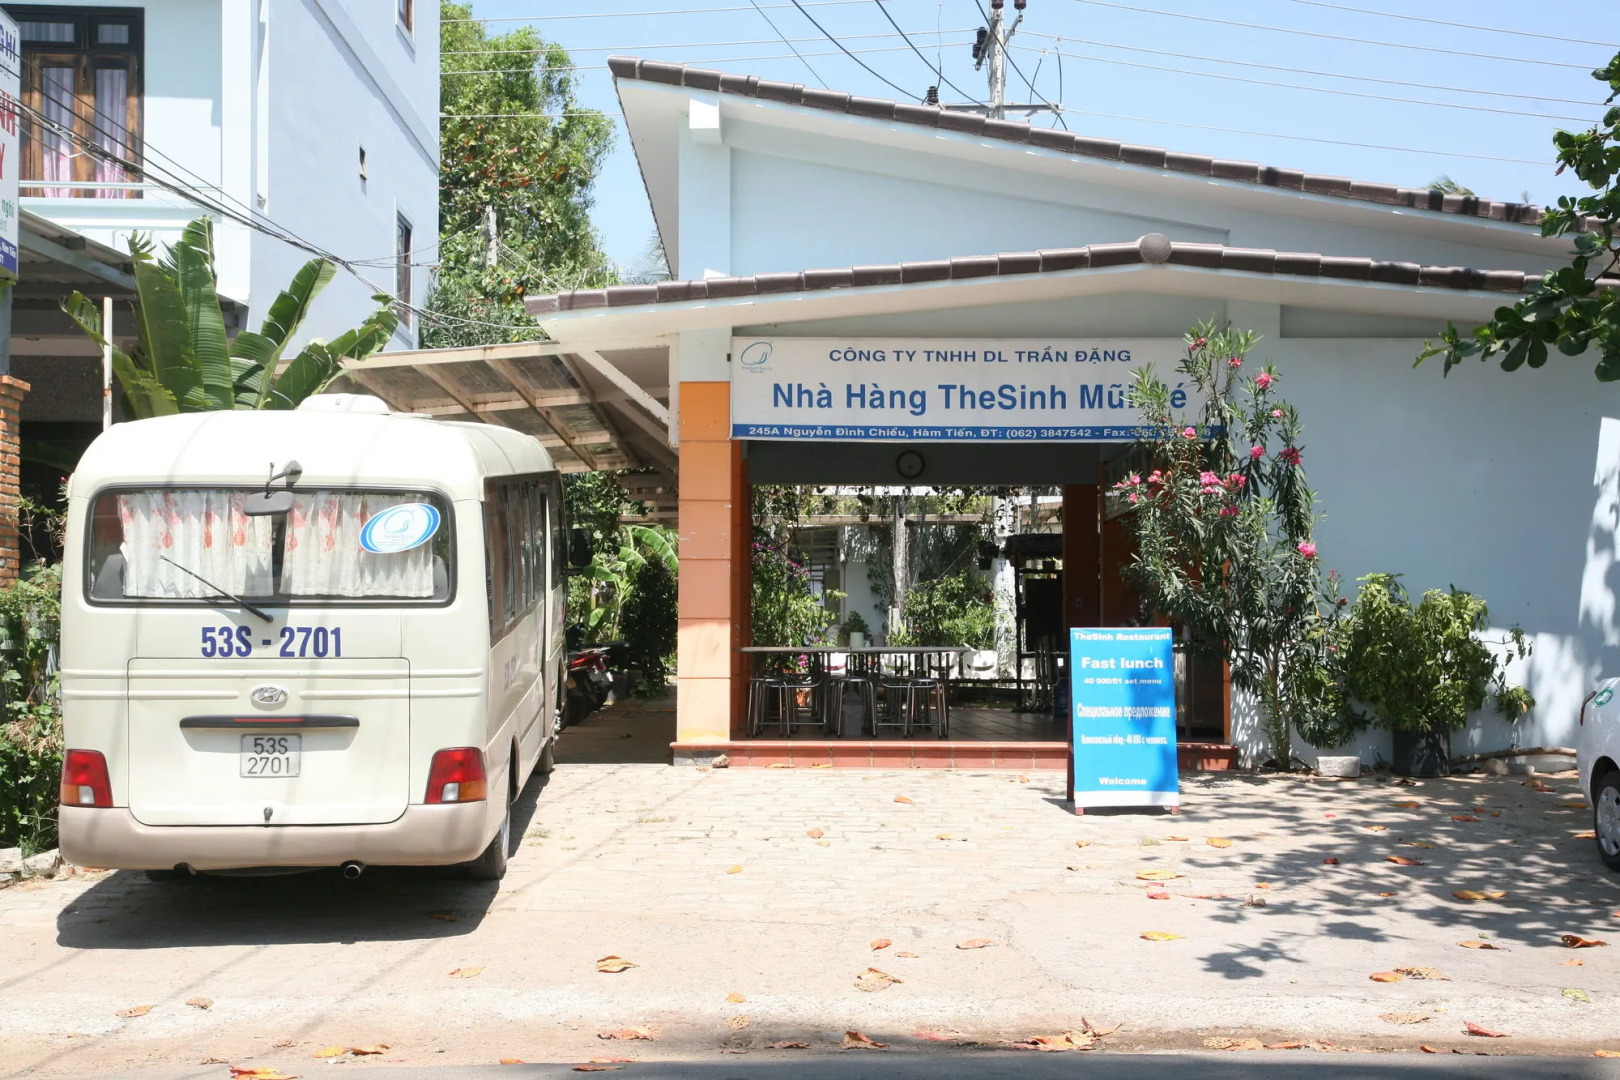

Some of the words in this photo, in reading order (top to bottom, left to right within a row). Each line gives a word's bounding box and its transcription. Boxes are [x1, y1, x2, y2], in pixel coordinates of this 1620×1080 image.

[829, 347, 886, 362] CÔNG
[893, 350, 917, 362] TY
[923, 350, 976, 362] TNHH
[984, 350, 1008, 363] DL
[1014, 345, 1068, 363] TRẦN
[1075, 347, 1131, 365] ĐẶNG
[773, 383, 833, 409] Nhà
[846, 383, 927, 416] Hàng
[938, 383, 1067, 410] TheSinh
[749, 427, 780, 436] 245A
[784, 426, 832, 438] Nguyễn
[836, 427, 865, 437] Đình
[869, 427, 909, 438] Chiểu,
[913, 428, 941, 437] Hàm
[945, 427, 977, 438] Tiến,
[981, 429, 1002, 437] ĐT:
[1006, 429, 1037, 438] (062)
[1041, 429, 1092, 437] 3847542
[1104, 428, 1130, 437] Fax:
[201, 626, 252, 657] 53S
[279, 626, 341, 657] 2701
[1073, 632, 1114, 641] TheSinh
[1116, 632, 1171, 641] Restaurant
[1081, 657, 1116, 669] Fast
[1120, 657, 1164, 669] lunch
[1083, 677, 1095, 685] 40
[1124, 705, 1171, 721] предложение
[253, 737, 288, 755] 53S
[247, 757, 290, 775] 2701
[1099, 777, 1147, 785] Welcome
